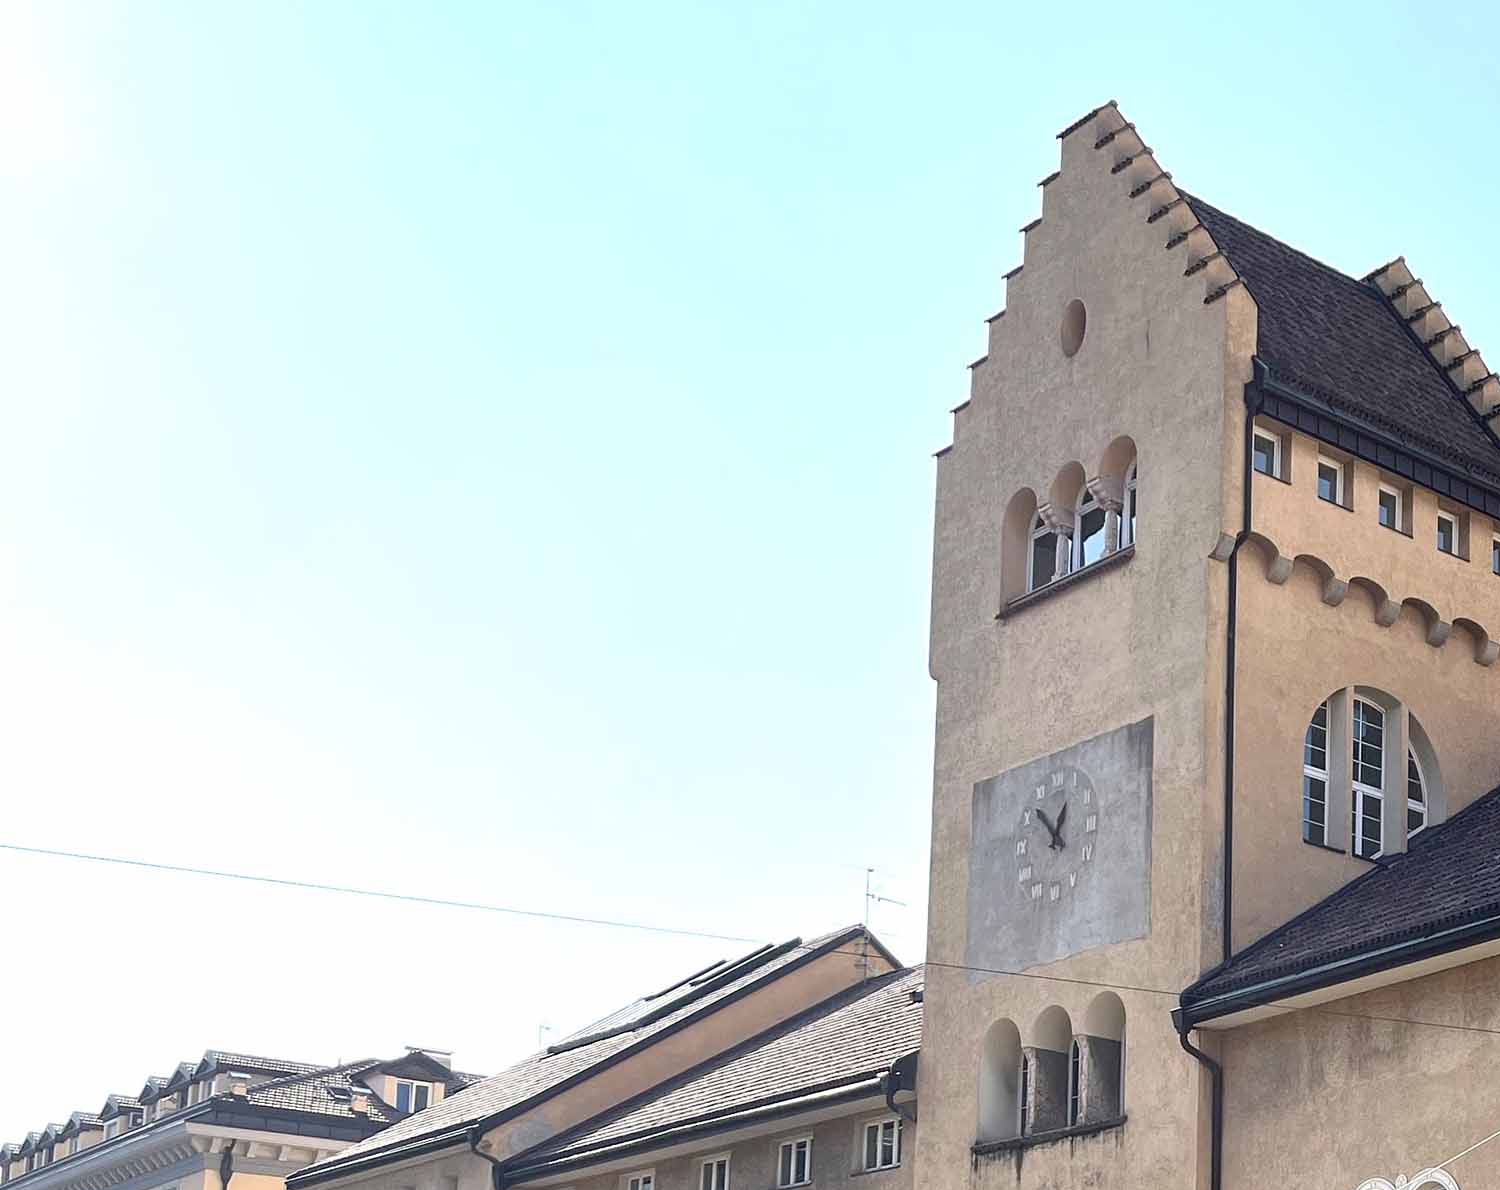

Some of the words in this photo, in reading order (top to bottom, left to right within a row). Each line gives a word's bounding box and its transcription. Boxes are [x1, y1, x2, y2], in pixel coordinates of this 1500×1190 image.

[1051, 770, 1064, 786] XII
[1073, 771, 1078, 786] I
[1036, 784, 1045, 800] XI
[1083, 788, 1091, 804] II
[1023, 809, 1031, 826] X
[1086, 815, 1096, 832] III
[1016, 839, 1027, 855] IX
[1082, 843, 1092, 861] IV
[1019, 865, 1032, 882] VIII
[1070, 871, 1076, 887] V
[1031, 883, 1042, 899] VII
[1050, 884, 1060, 901] VI
